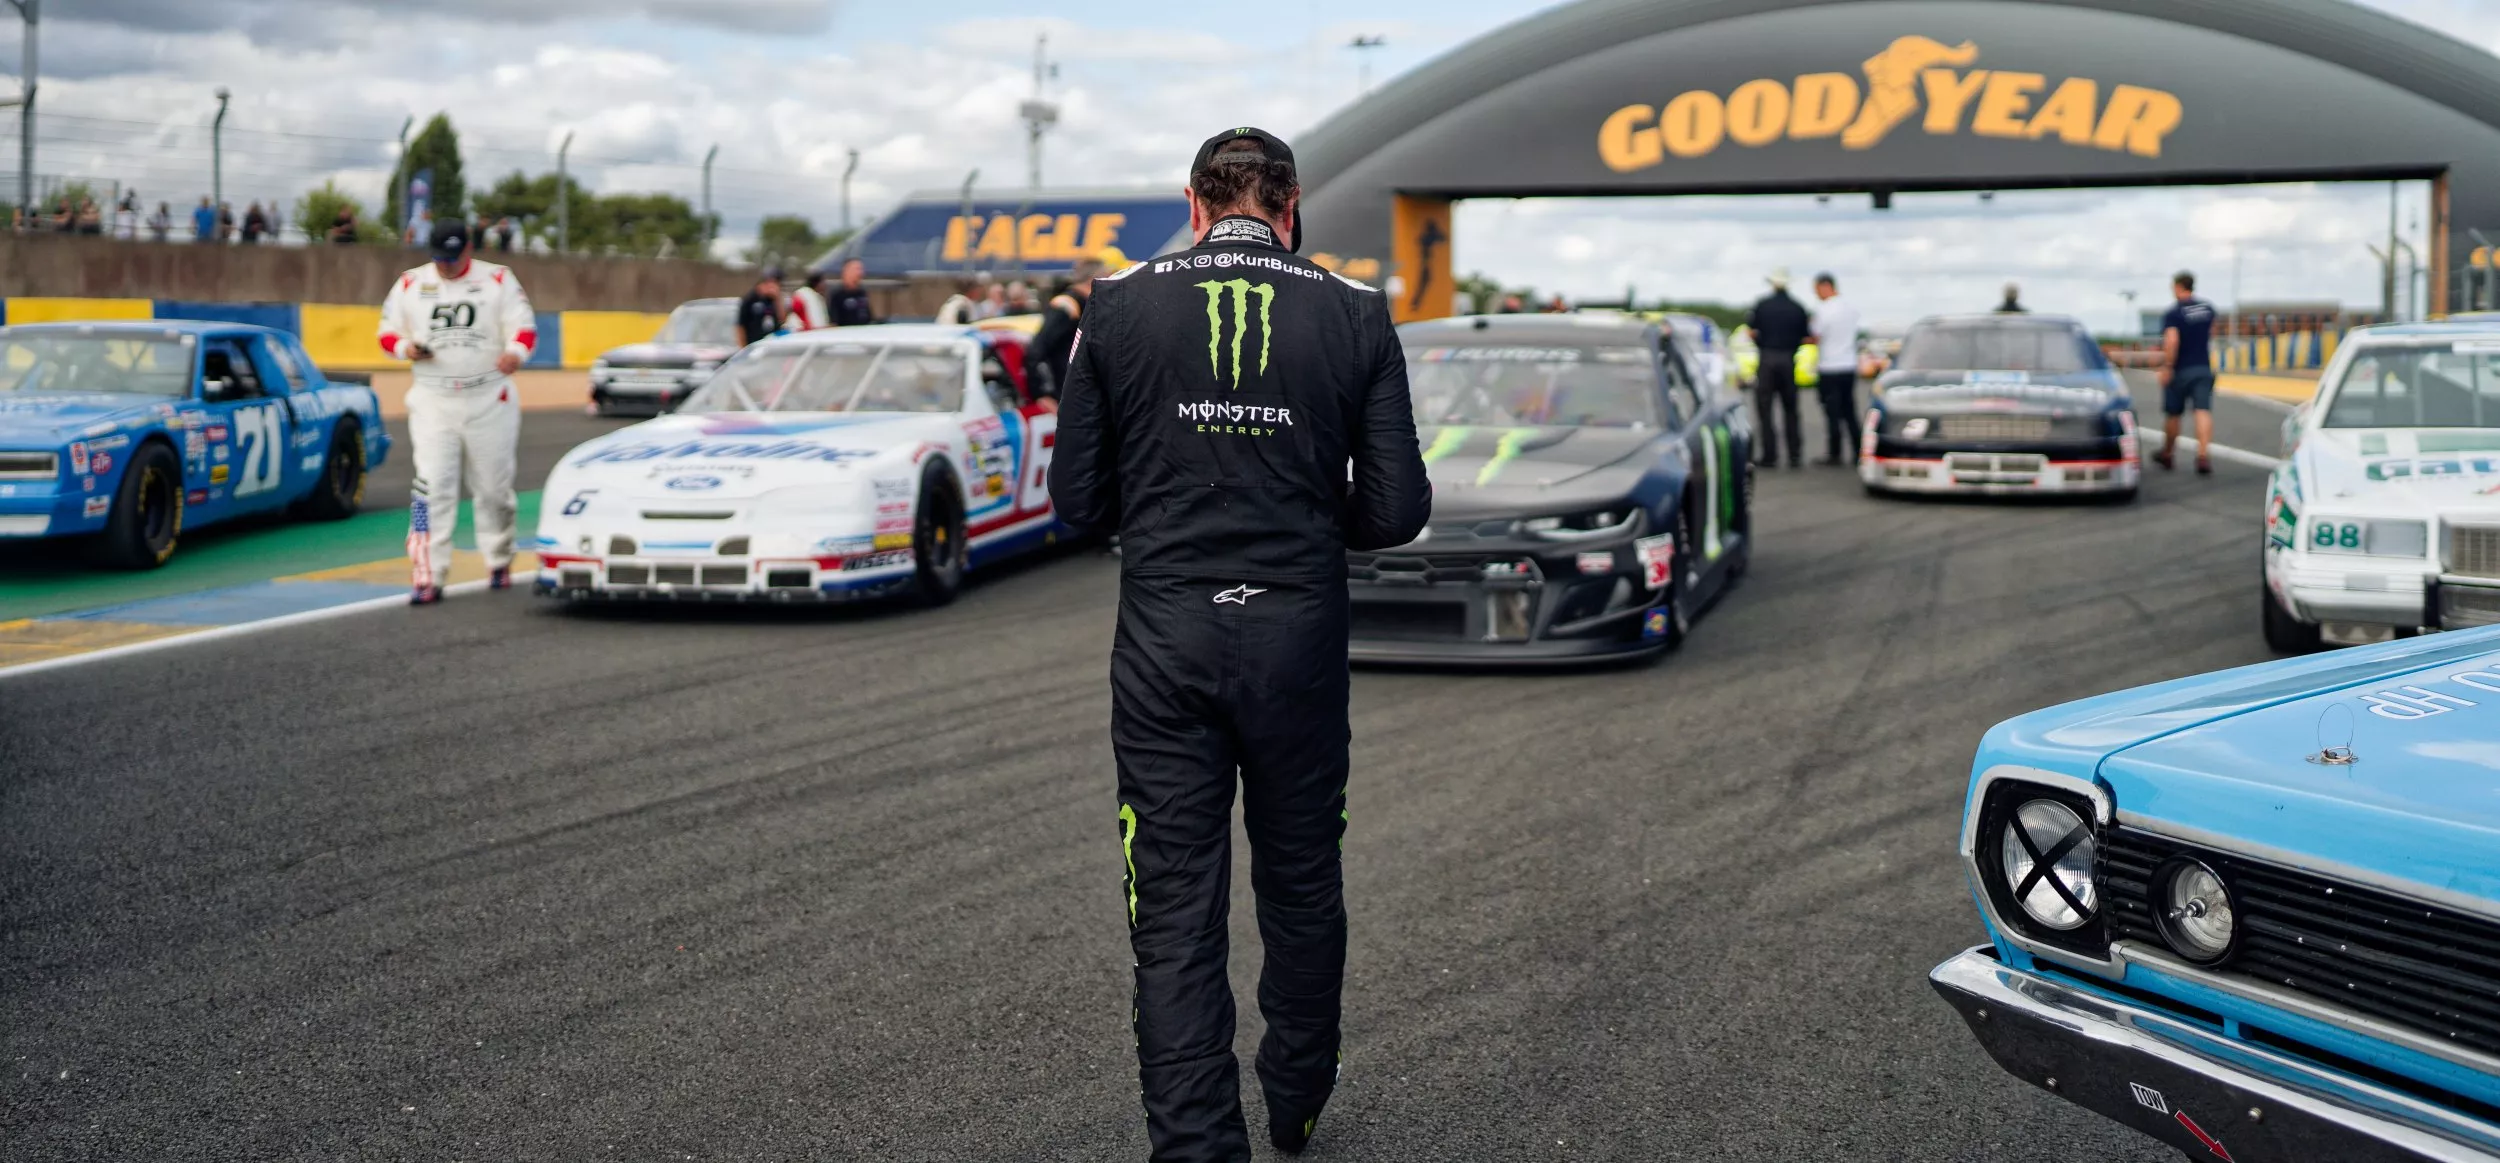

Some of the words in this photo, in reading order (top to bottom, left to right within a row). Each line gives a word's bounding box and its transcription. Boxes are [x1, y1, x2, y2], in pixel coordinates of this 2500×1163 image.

[1598, 67, 2183, 173] GOODYEAR
[940, 212, 1127, 262] EAGLE
[1214, 253, 1323, 280] @KurtBusch
[430, 303, 476, 331] 50
[1178, 399, 1294, 426] MONSTER
[1197, 424, 1275, 437] ENERGY
[233, 404, 282, 499] 71
[562, 489, 599, 516] 6
[2314, 522, 2359, 549] 88
[2357, 685, 2480, 720] HP
[2131, 1084, 2165, 1112] TOW
